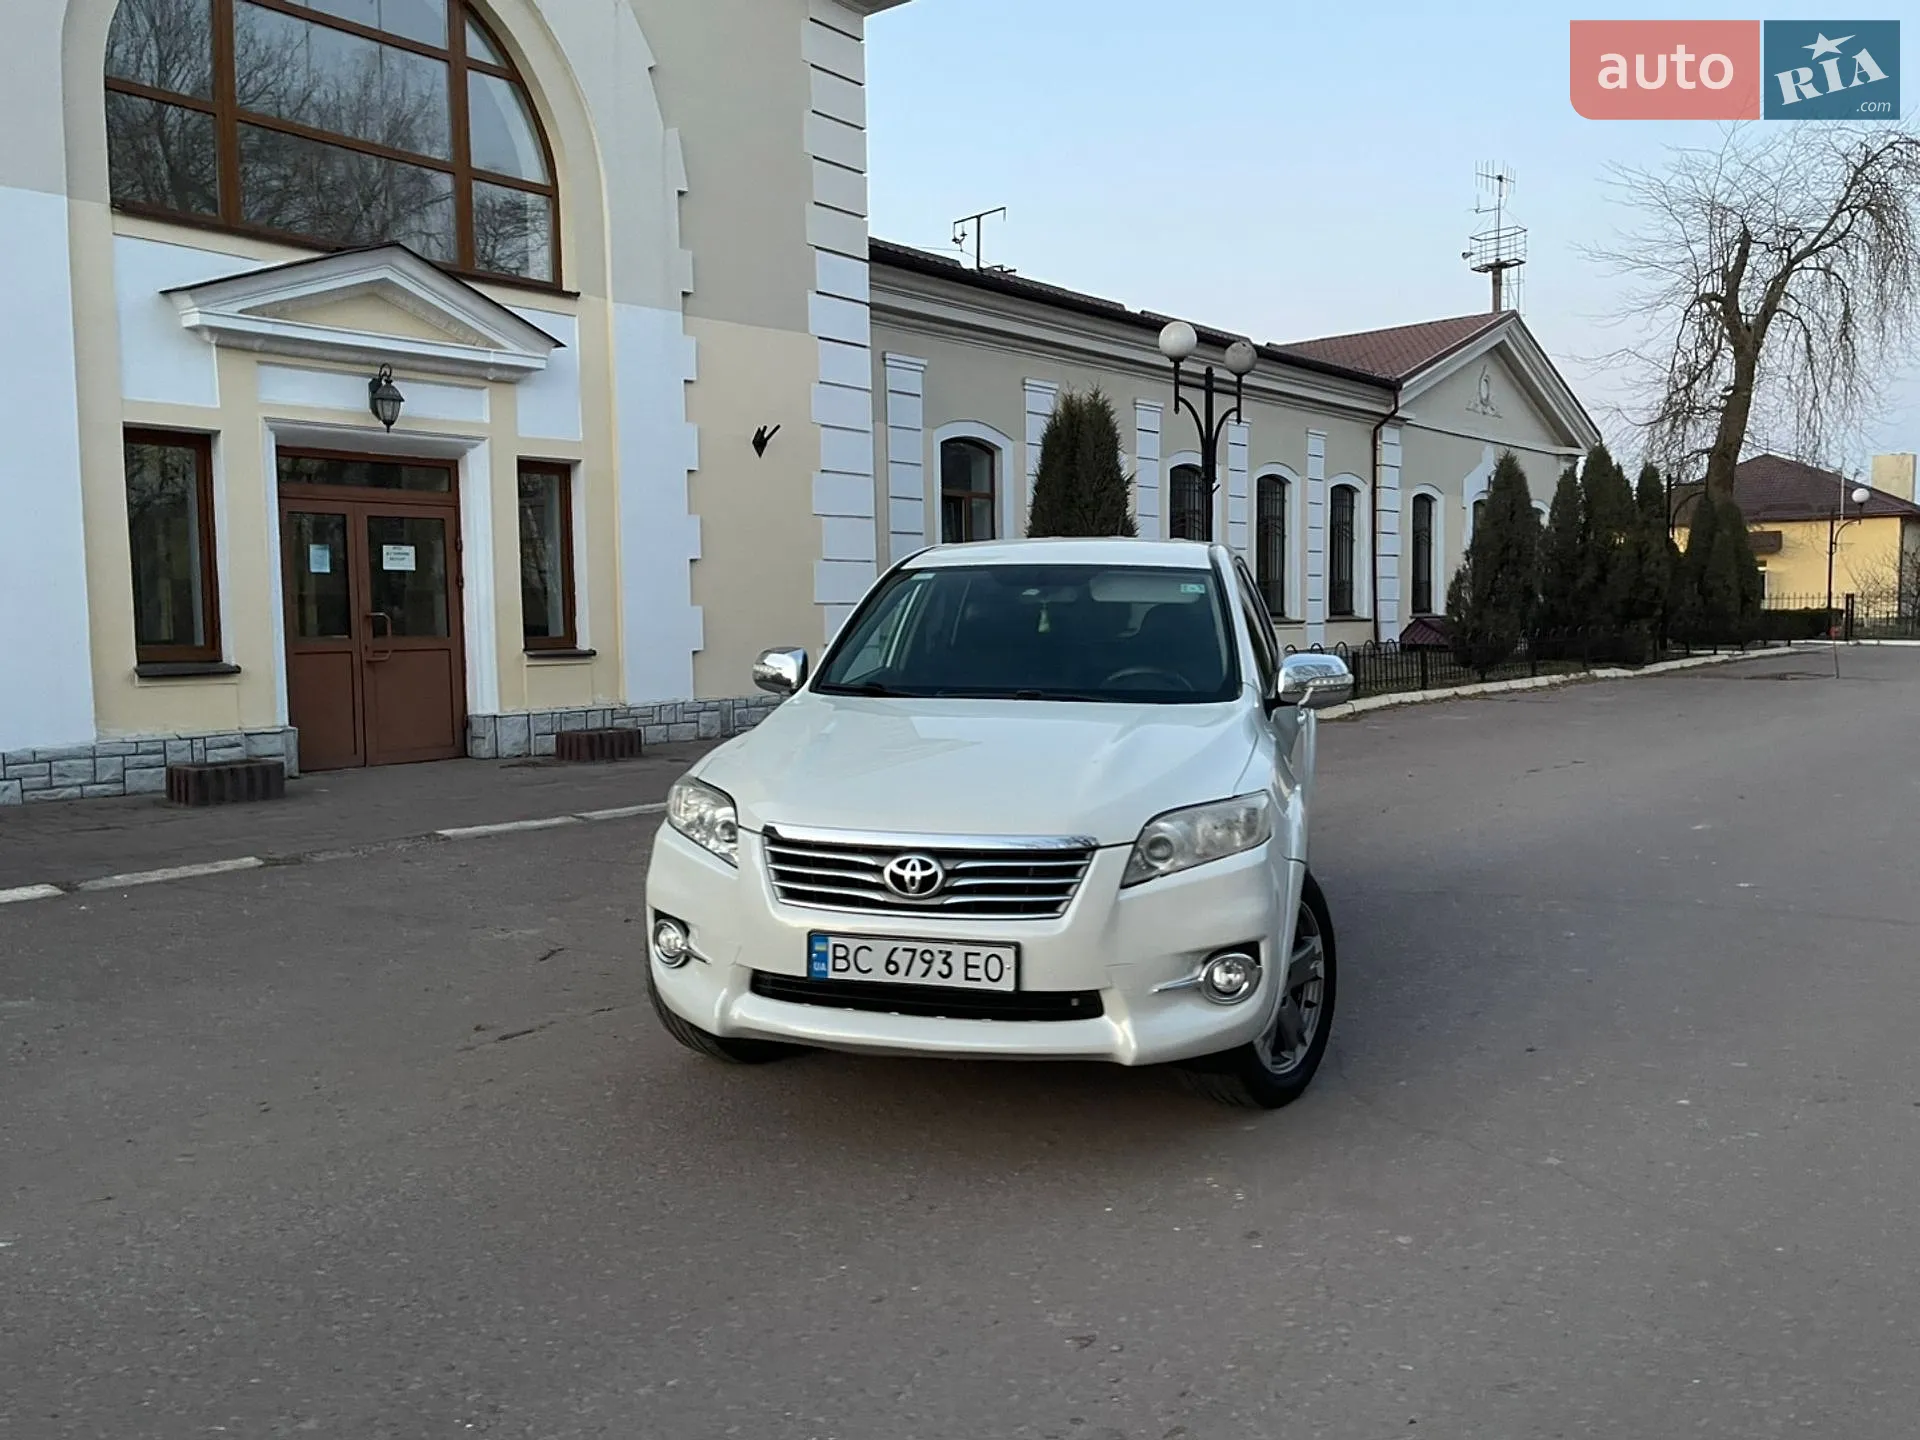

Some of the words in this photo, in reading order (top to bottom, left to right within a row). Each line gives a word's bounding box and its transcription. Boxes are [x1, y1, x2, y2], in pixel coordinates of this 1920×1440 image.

[813, 961, 827, 971] UA
[832, 943, 873, 974] BC
[884, 946, 953, 980] 6793
[964, 952, 1004, 983] EO
